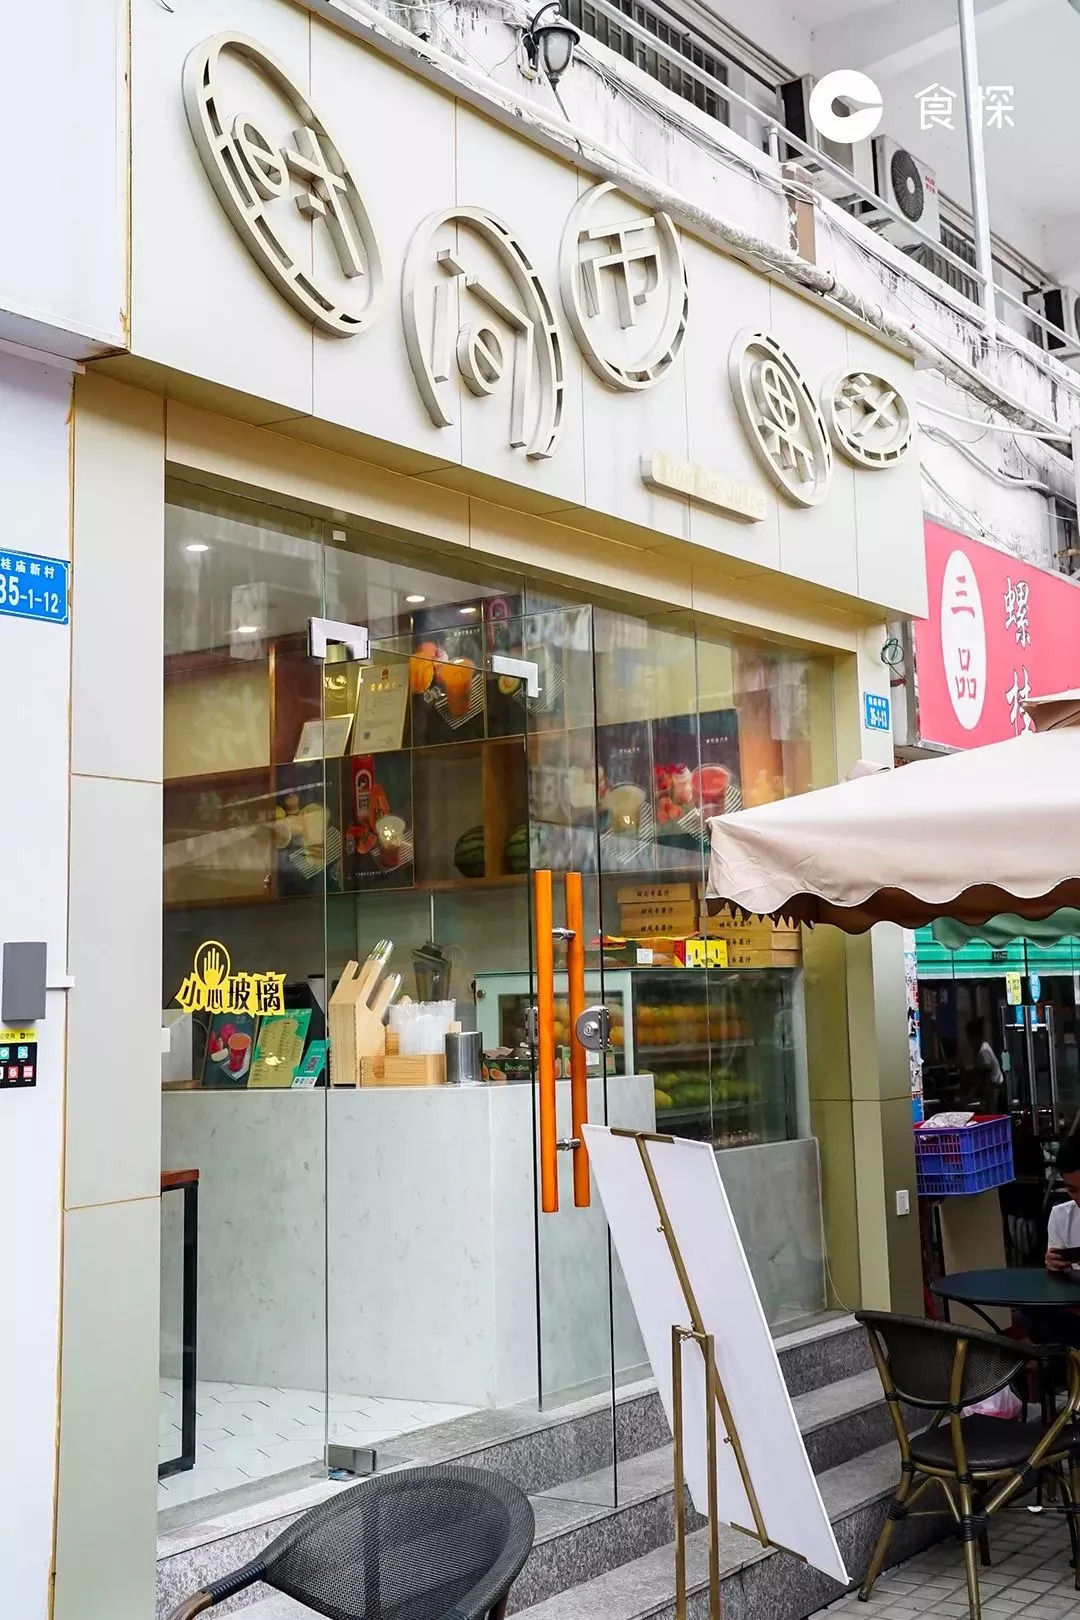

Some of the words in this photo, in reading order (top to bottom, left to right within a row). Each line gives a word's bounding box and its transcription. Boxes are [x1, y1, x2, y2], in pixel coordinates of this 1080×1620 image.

[1, 557, 55, 579] 桂庙新村
[180, 976, 283, 1013] 小心玻璃
